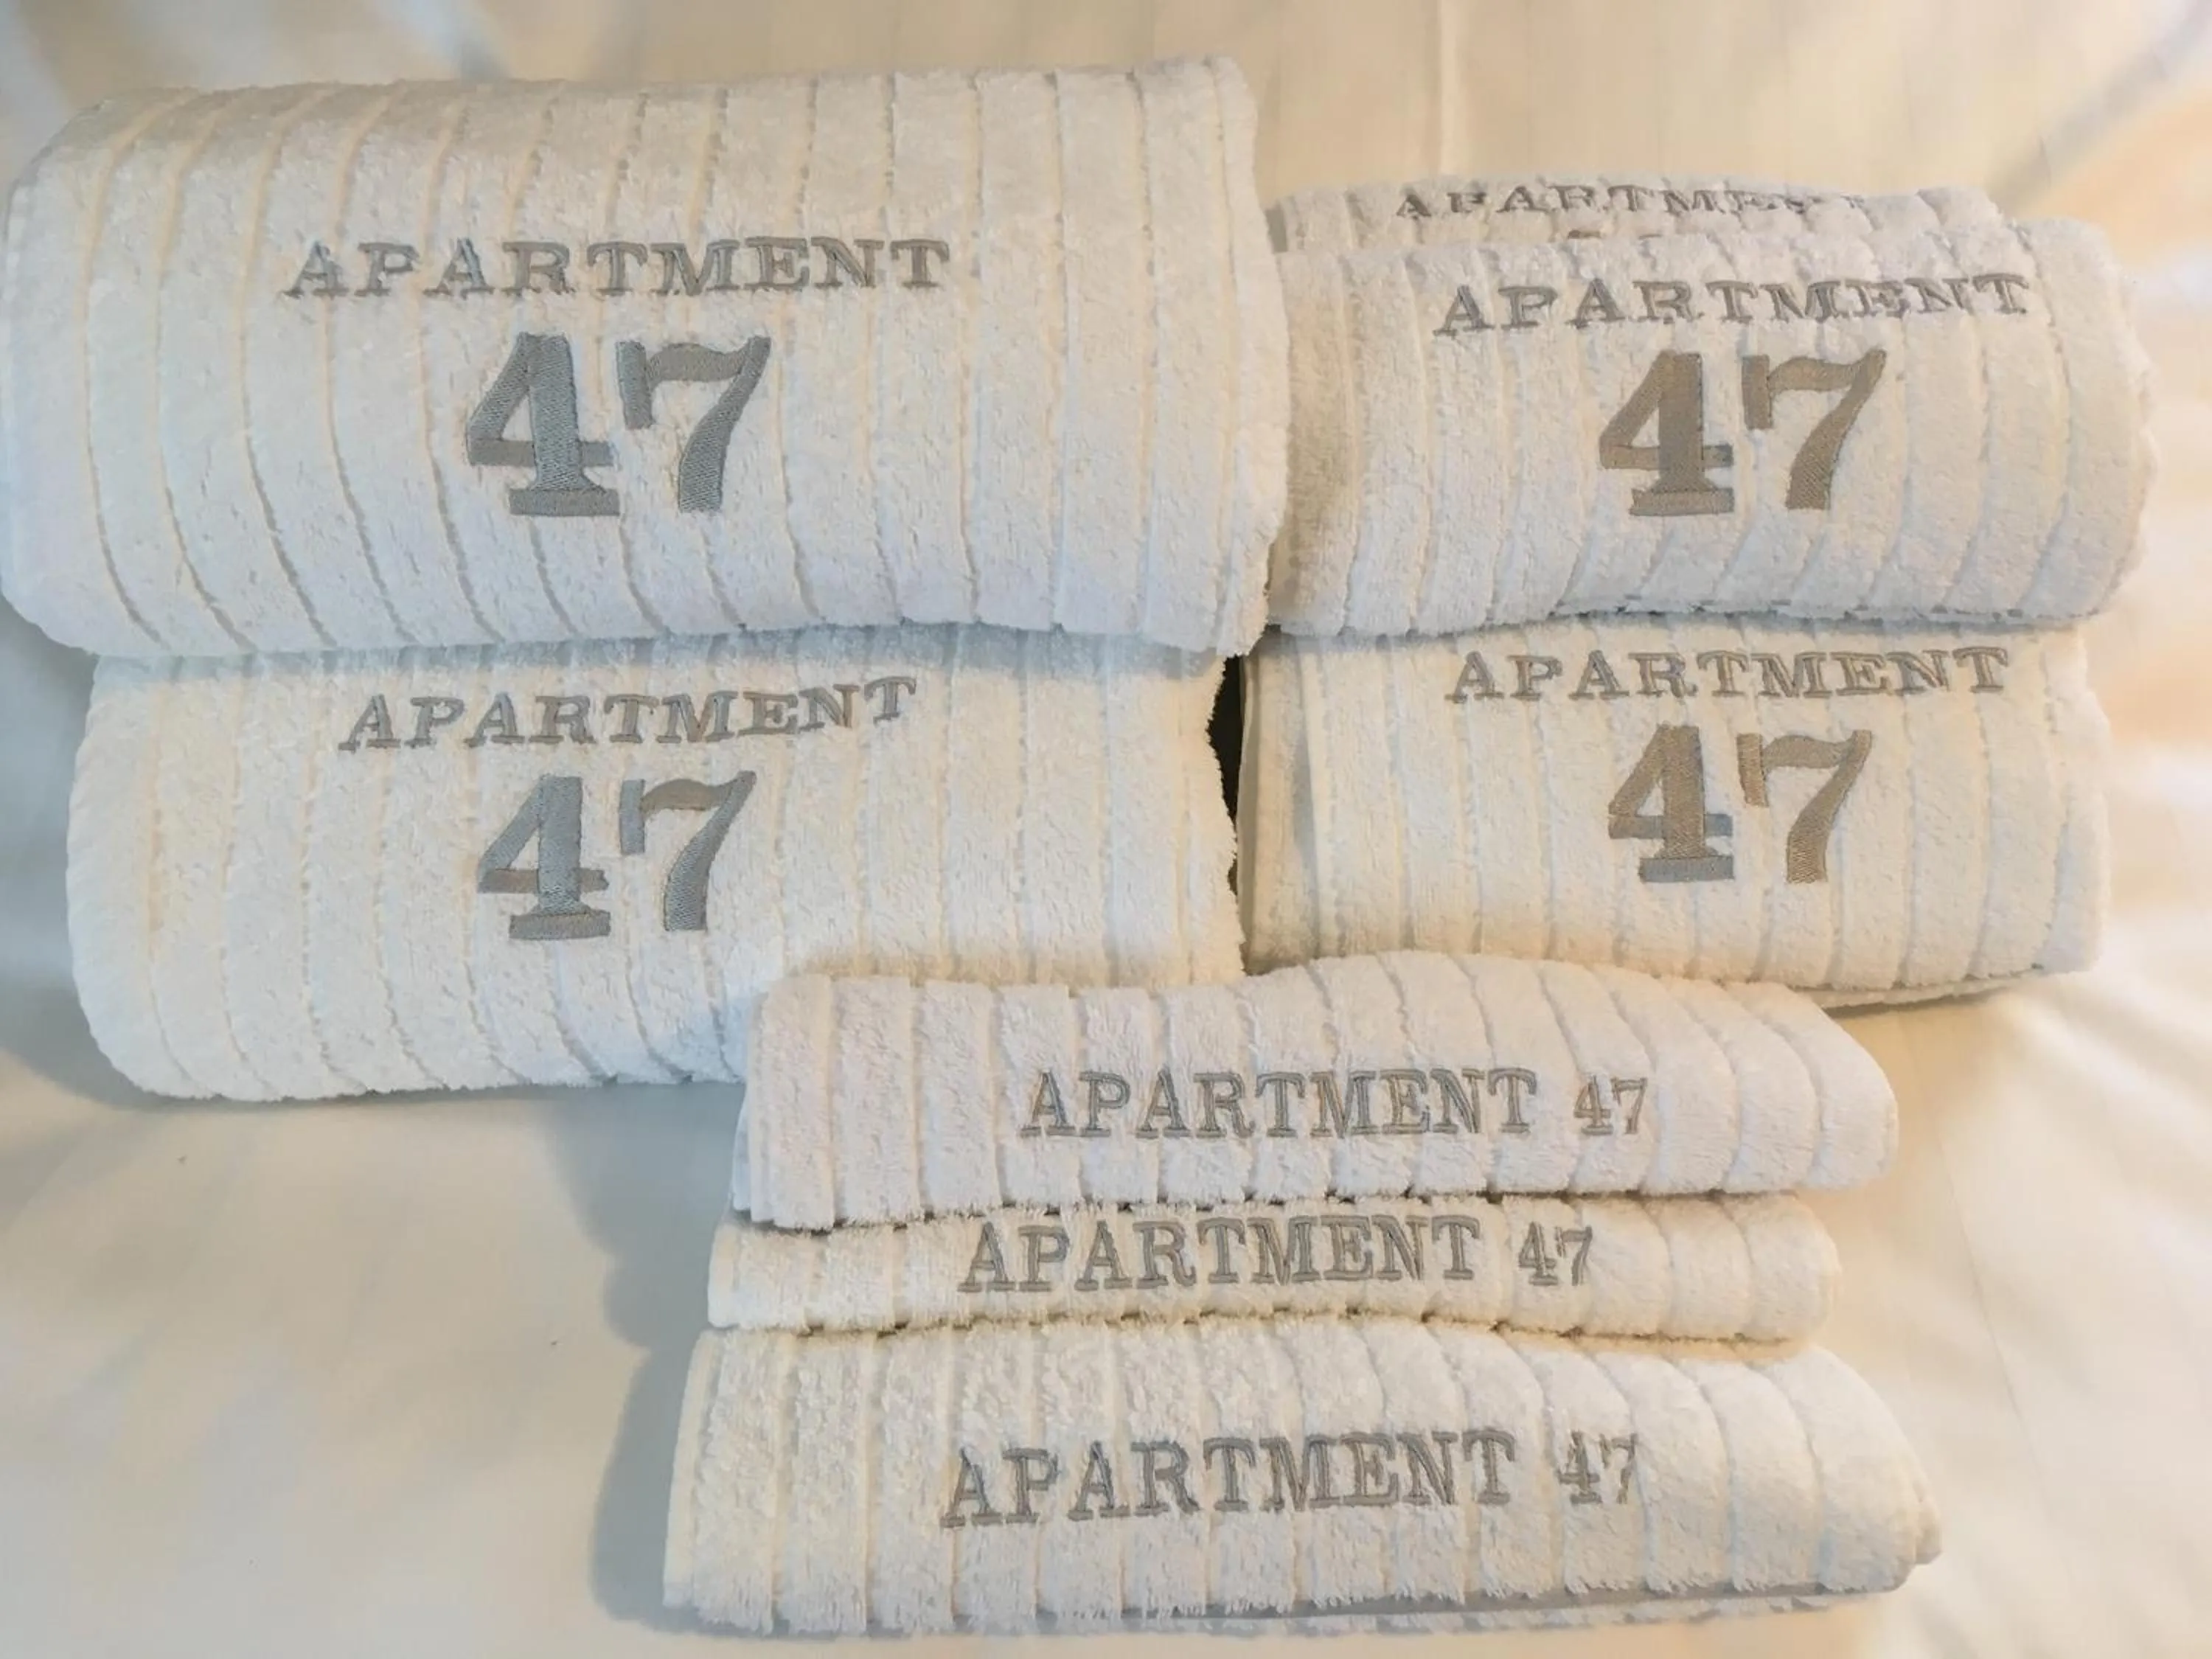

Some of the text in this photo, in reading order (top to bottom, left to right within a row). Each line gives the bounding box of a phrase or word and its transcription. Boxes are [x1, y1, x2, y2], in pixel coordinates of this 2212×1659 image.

[285, 236, 950, 298] APARTMENT
[1433, 273, 2029, 336] APARTMENT
[465, 331, 773, 517] 47
[1599, 349, 1888, 516] 47
[338, 675, 917, 752] APARTMENT
[1445, 646, 2008, 703] APARTMENT
[1607, 722, 1874, 885] 47
[477, 771, 758, 941] 47
[1020, 1067, 1649, 1139] APARTMENT 47
[958, 1214, 1594, 1293] APARTMENT 47
[939, 1428, 1637, 1529] APARTMENT 47
